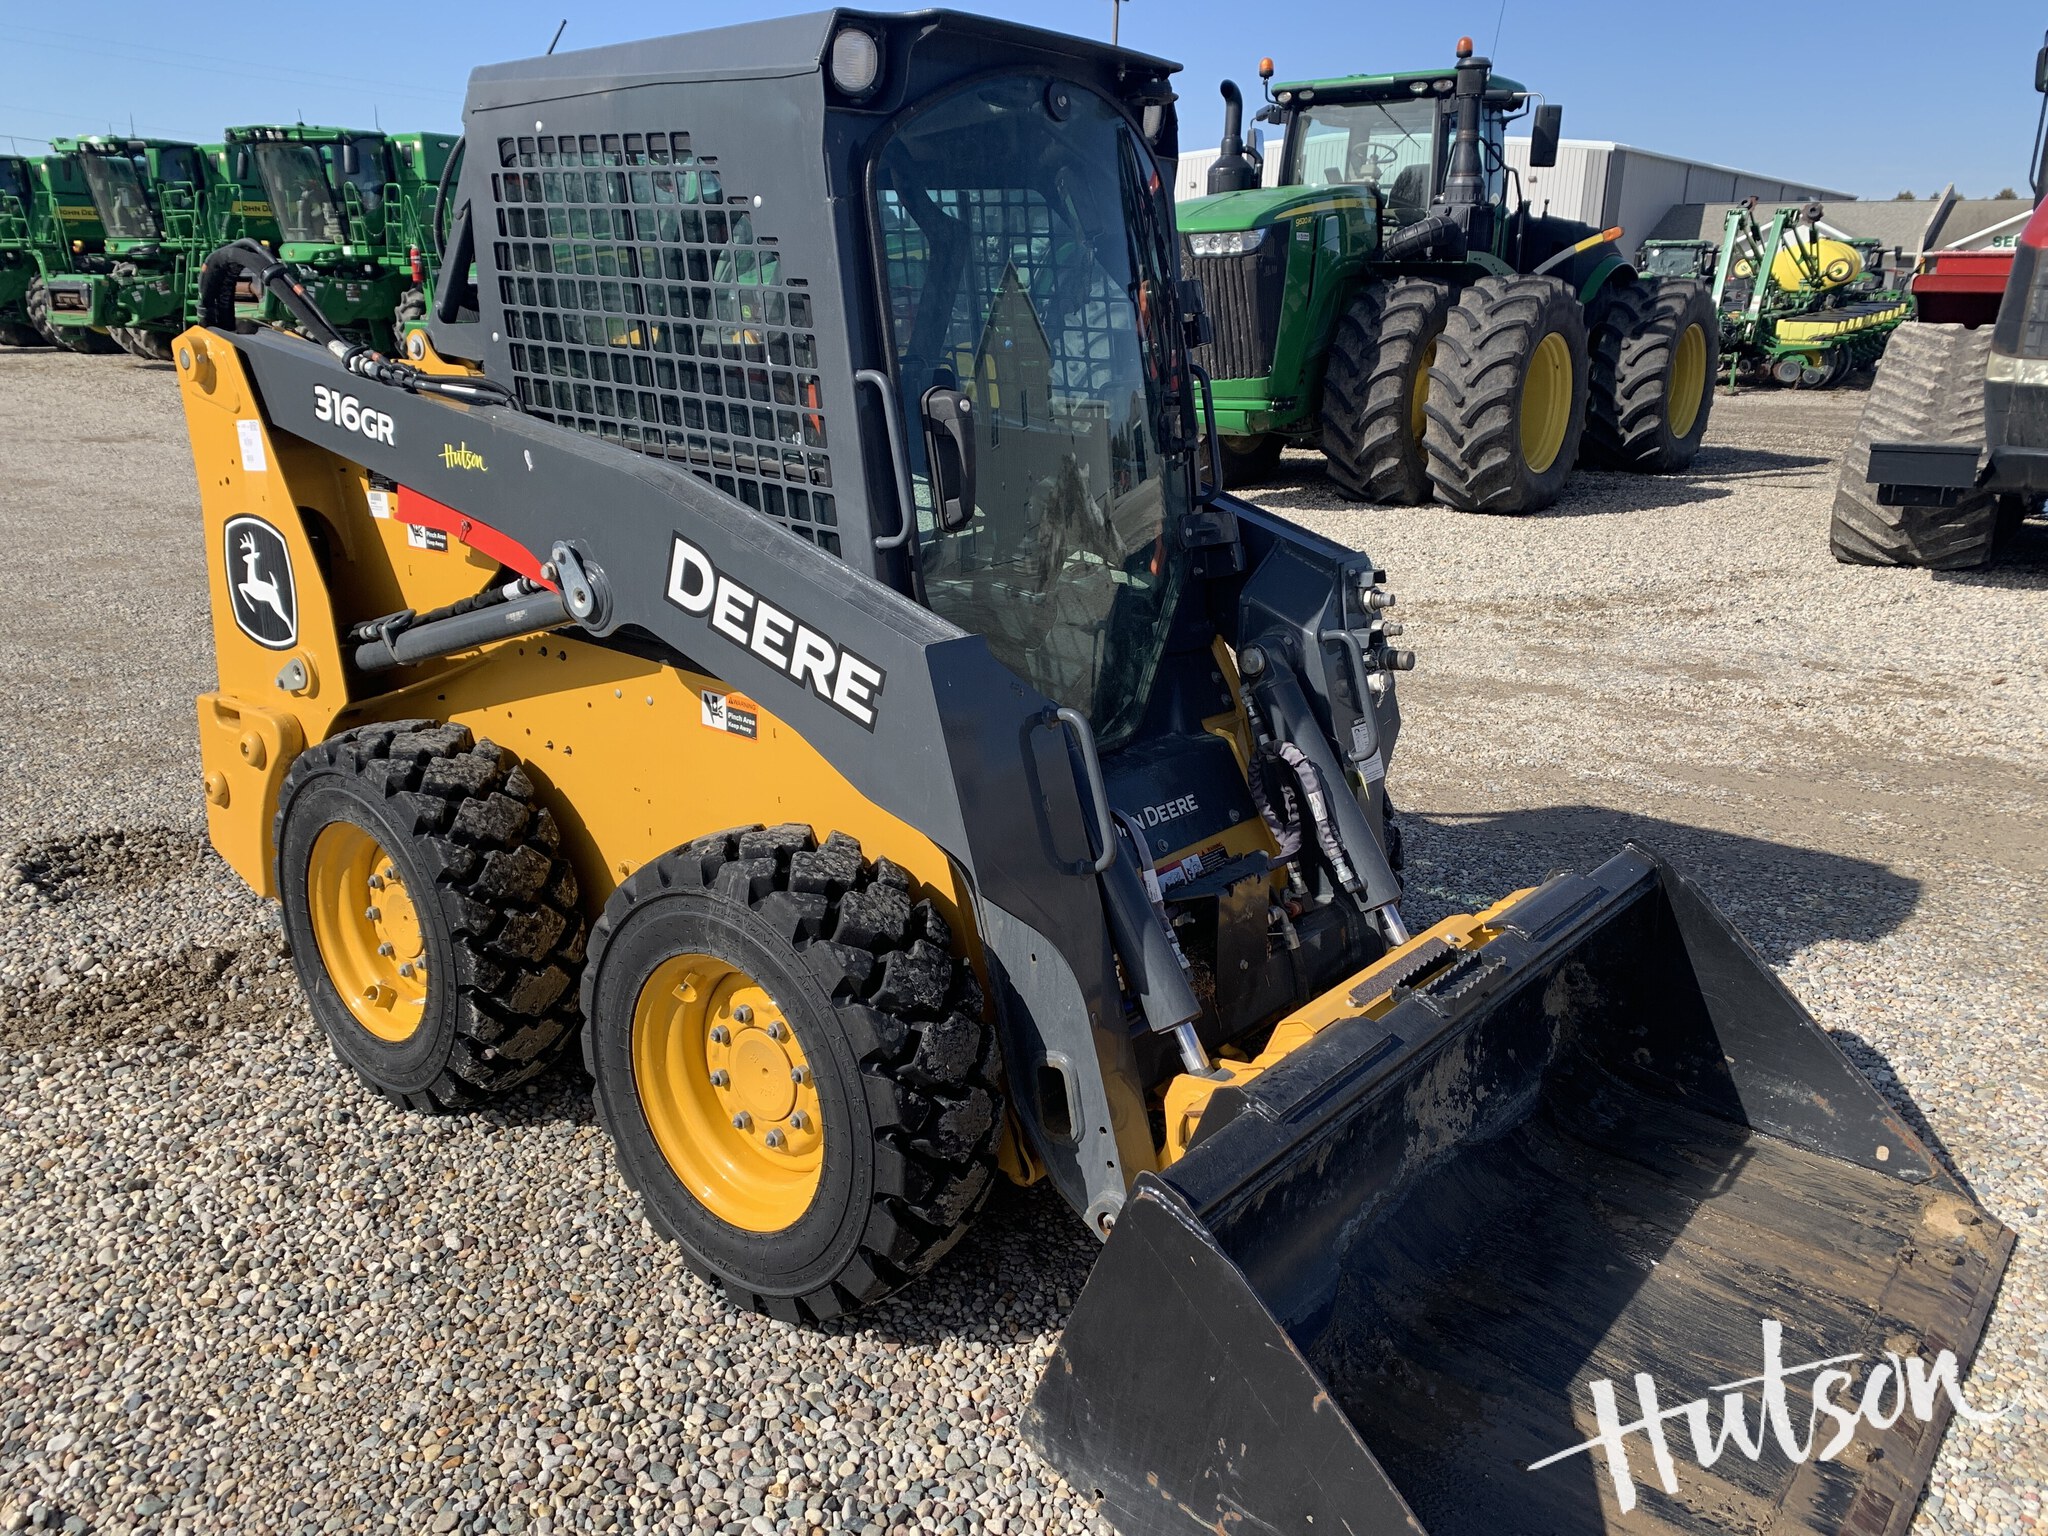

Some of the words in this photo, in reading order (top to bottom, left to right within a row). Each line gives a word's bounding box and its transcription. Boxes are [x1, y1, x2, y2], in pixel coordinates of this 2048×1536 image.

[313, 384, 395, 447] 316GR
[438, 441, 488, 471] Hutson
[667, 536, 882, 724] DEERE
[727, 711, 742, 722] Pinch
[742, 716, 755, 726] Area
[732, 699, 756, 711] WARNING
[727, 721, 740, 730] Keep
[739, 725, 752, 734] Away
[1143, 793, 1199, 827] DEERE
